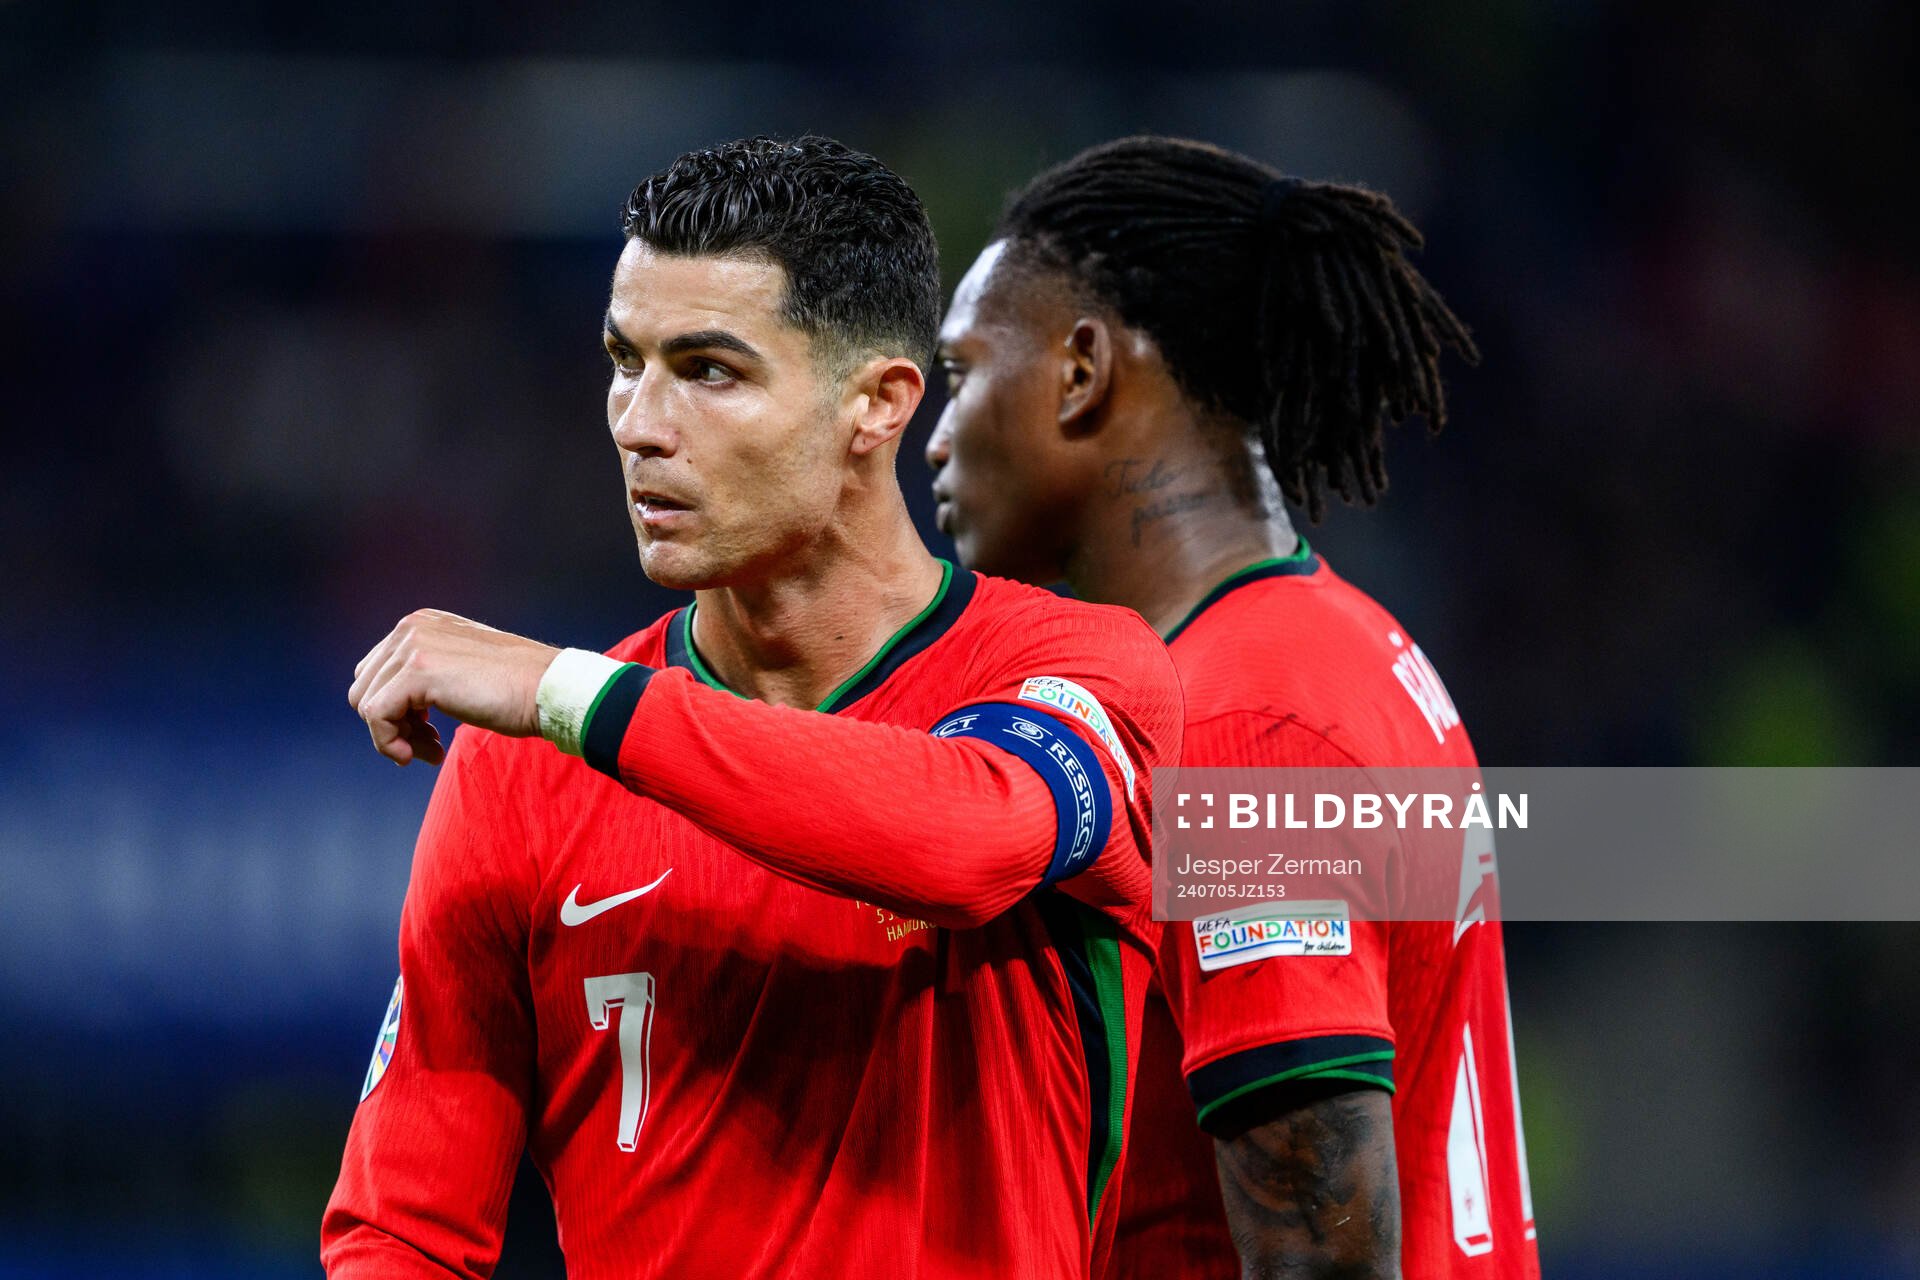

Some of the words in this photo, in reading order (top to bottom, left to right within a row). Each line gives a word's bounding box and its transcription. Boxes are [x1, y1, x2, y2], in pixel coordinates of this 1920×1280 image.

[1050, 742, 1093, 860] RESPECT
[1197, 917, 1232, 933] UEFA
[1199, 909, 1345, 953] FOUNDATION
[584, 972, 655, 1153] 7
